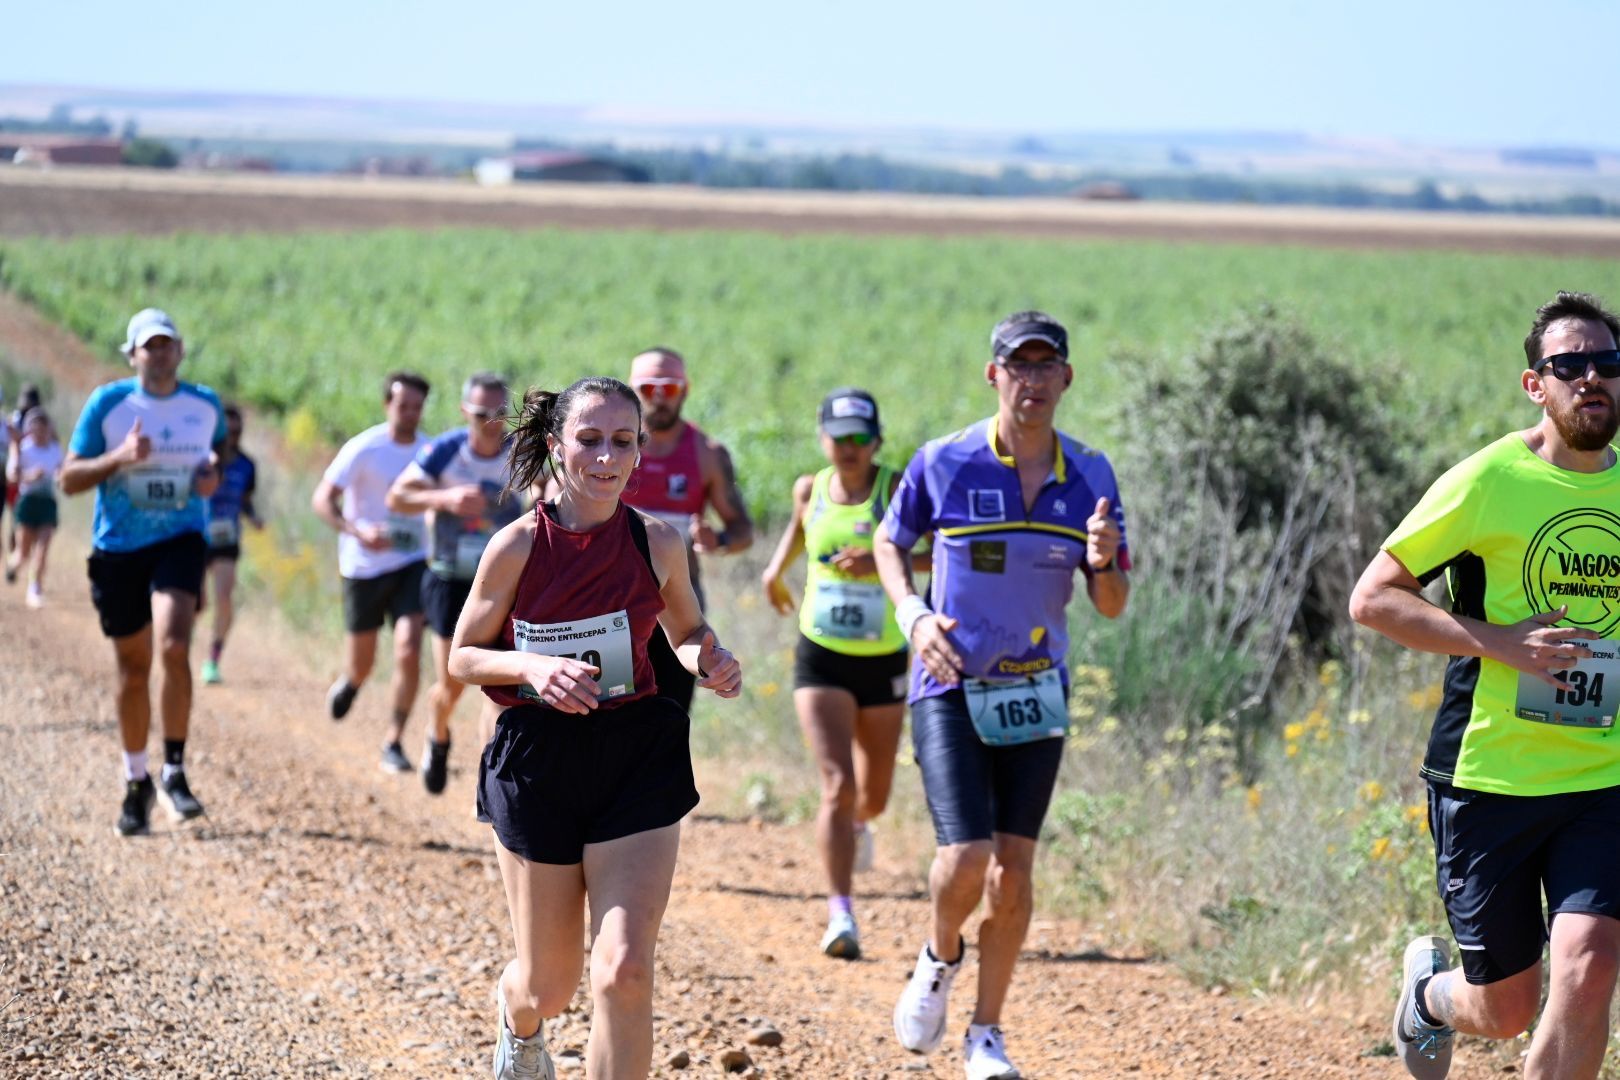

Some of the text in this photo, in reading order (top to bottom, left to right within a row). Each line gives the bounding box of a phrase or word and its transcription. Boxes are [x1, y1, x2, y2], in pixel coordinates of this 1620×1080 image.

[145, 481, 175, 500] 153
[1558, 552, 1620, 577] VAGOS
[1548, 581, 1619, 599] PERMANENTES
[830, 603, 864, 628] 125
[546, 626, 572, 634] POPULAR
[557, 627, 607, 642] ENTRECEPAS
[1553, 670, 1604, 707] 134
[993, 697, 1042, 729] 163
